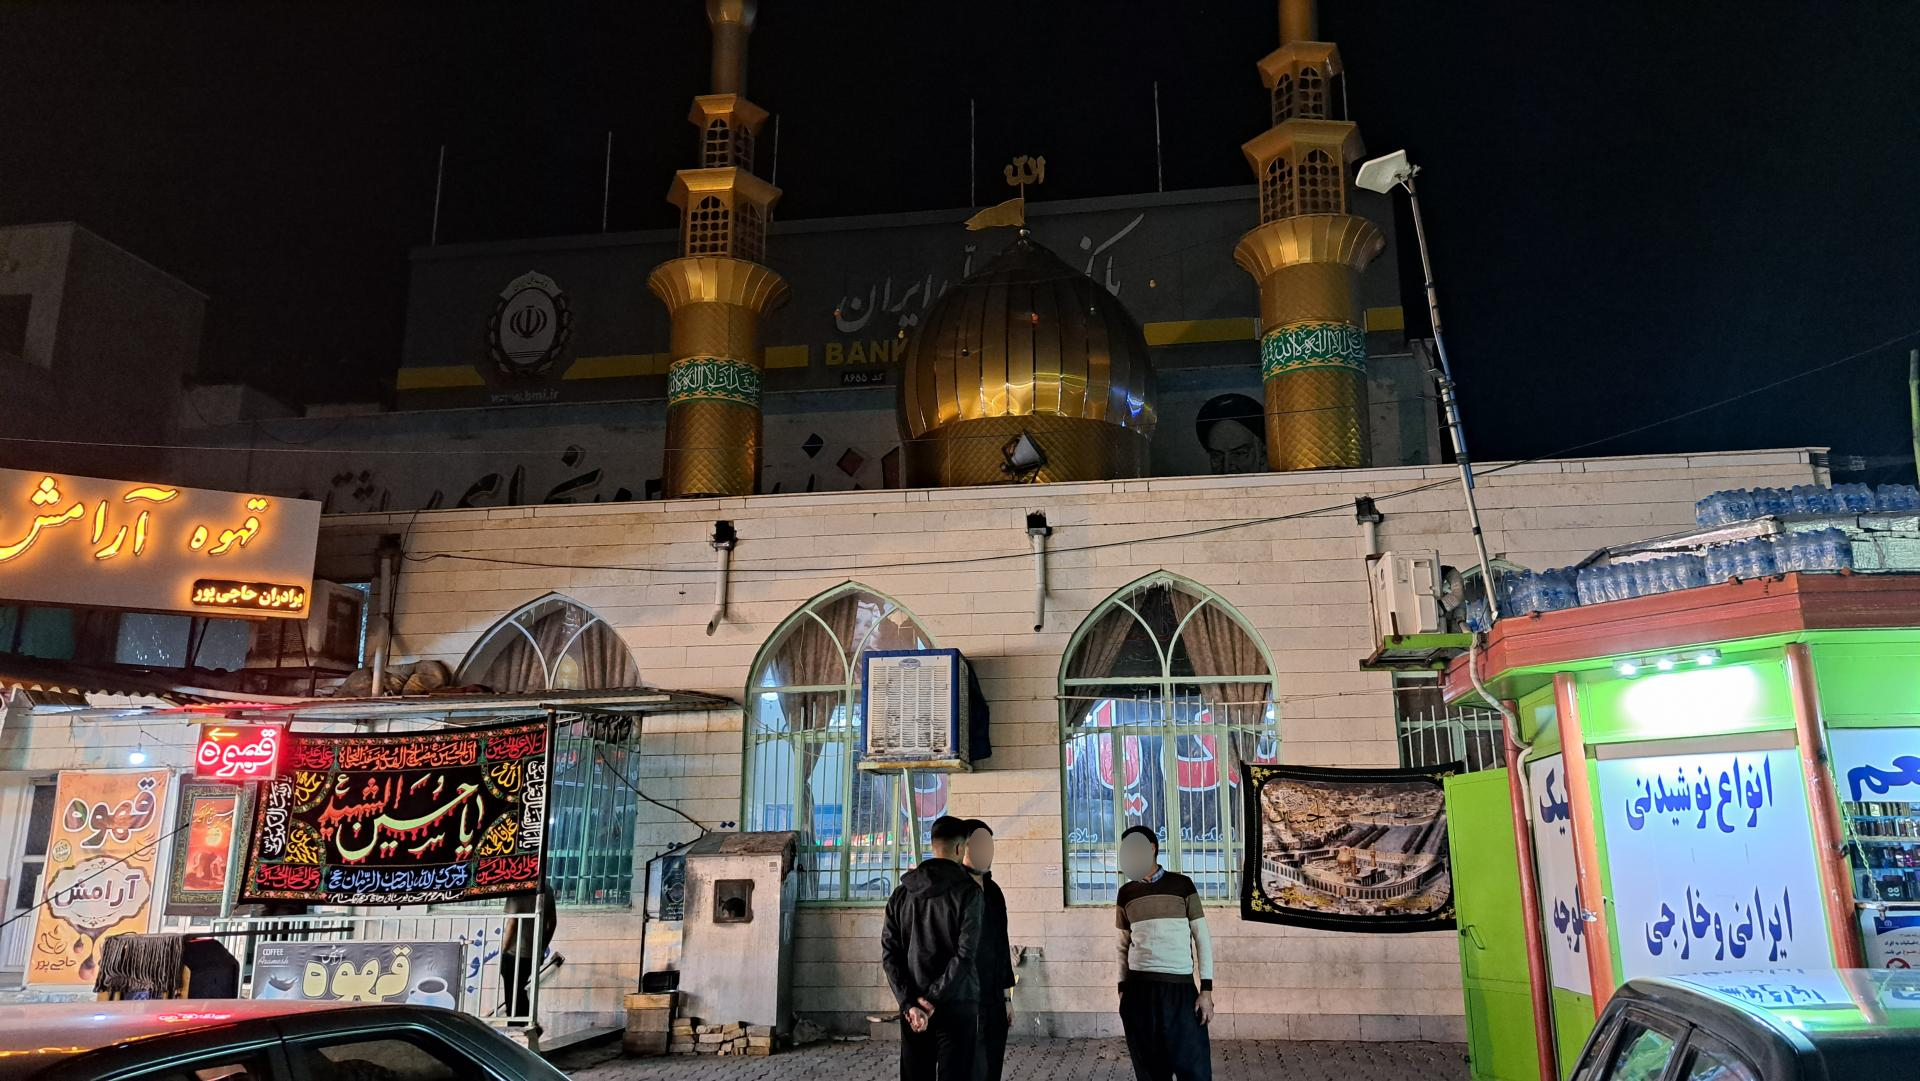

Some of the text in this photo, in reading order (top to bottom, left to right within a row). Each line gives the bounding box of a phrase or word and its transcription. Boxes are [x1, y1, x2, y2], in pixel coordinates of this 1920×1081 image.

[0, 475, 269, 562] قهوه آرامش
[258, 586, 303, 608] برادران
[198, 728, 277, 777] قهوه
[63, 777, 157, 849] قهوه
[1539, 767, 1571, 835] یک
[1625, 753, 1773, 833] انواع نوشیدنی
[54, 873, 141, 909] آرامش
[1553, 883, 1585, 953] لوچه
[1645, 884, 1793, 962] ایرانی و خارجی
[262, 948, 284, 956] COFFEE
[302, 945, 413, 1002] قهوه
